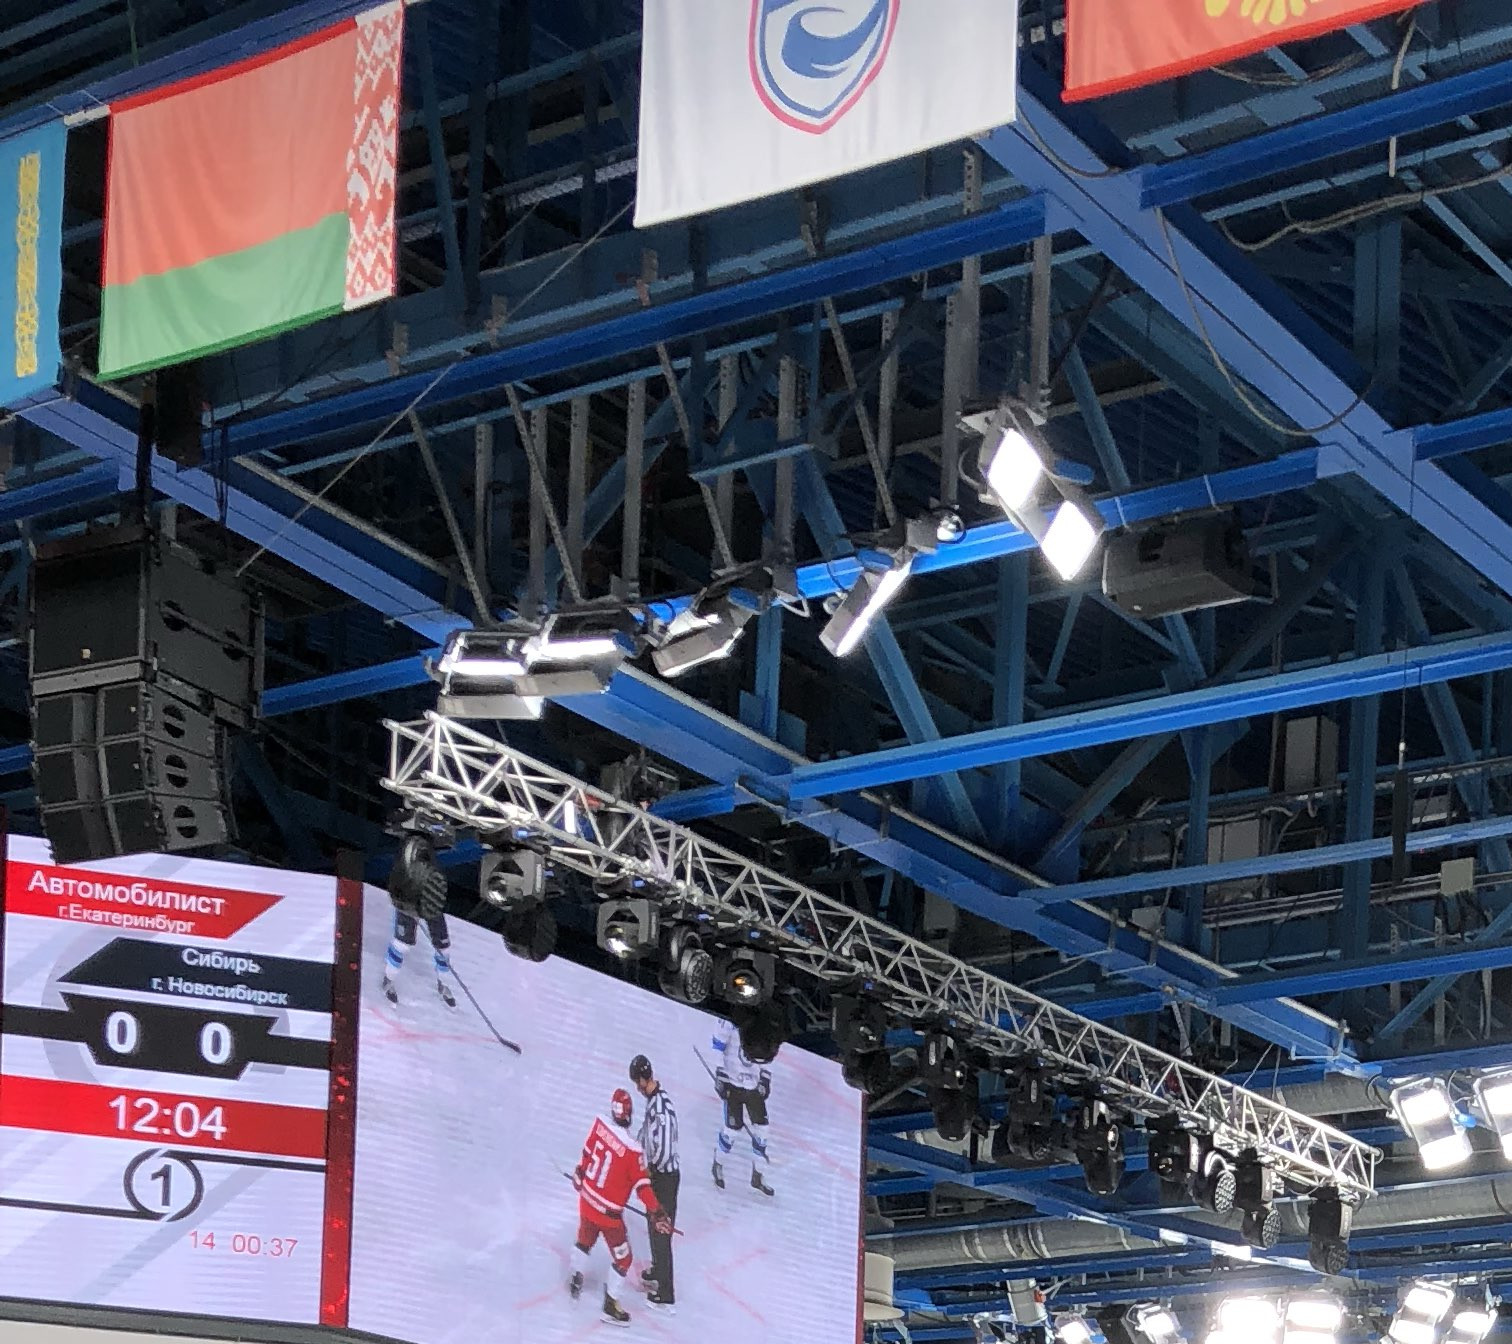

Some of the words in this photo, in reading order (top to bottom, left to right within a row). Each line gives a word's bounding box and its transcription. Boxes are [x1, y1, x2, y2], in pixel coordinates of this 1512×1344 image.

[27, 870, 225, 915] Автомобилист
[182, 948, 262, 974] Сибирь
[168, 977, 288, 1005] Новосибирск
[106, 1011, 139, 1053] 0
[201, 1022, 232, 1064] 0
[109, 1095, 227, 1140] 12:04
[151, 1164, 172, 1206] 1
[586, 1141, 612, 1188] 51
[190, 1230, 216, 1250] 14
[232, 1234, 298, 1257] 00:37
